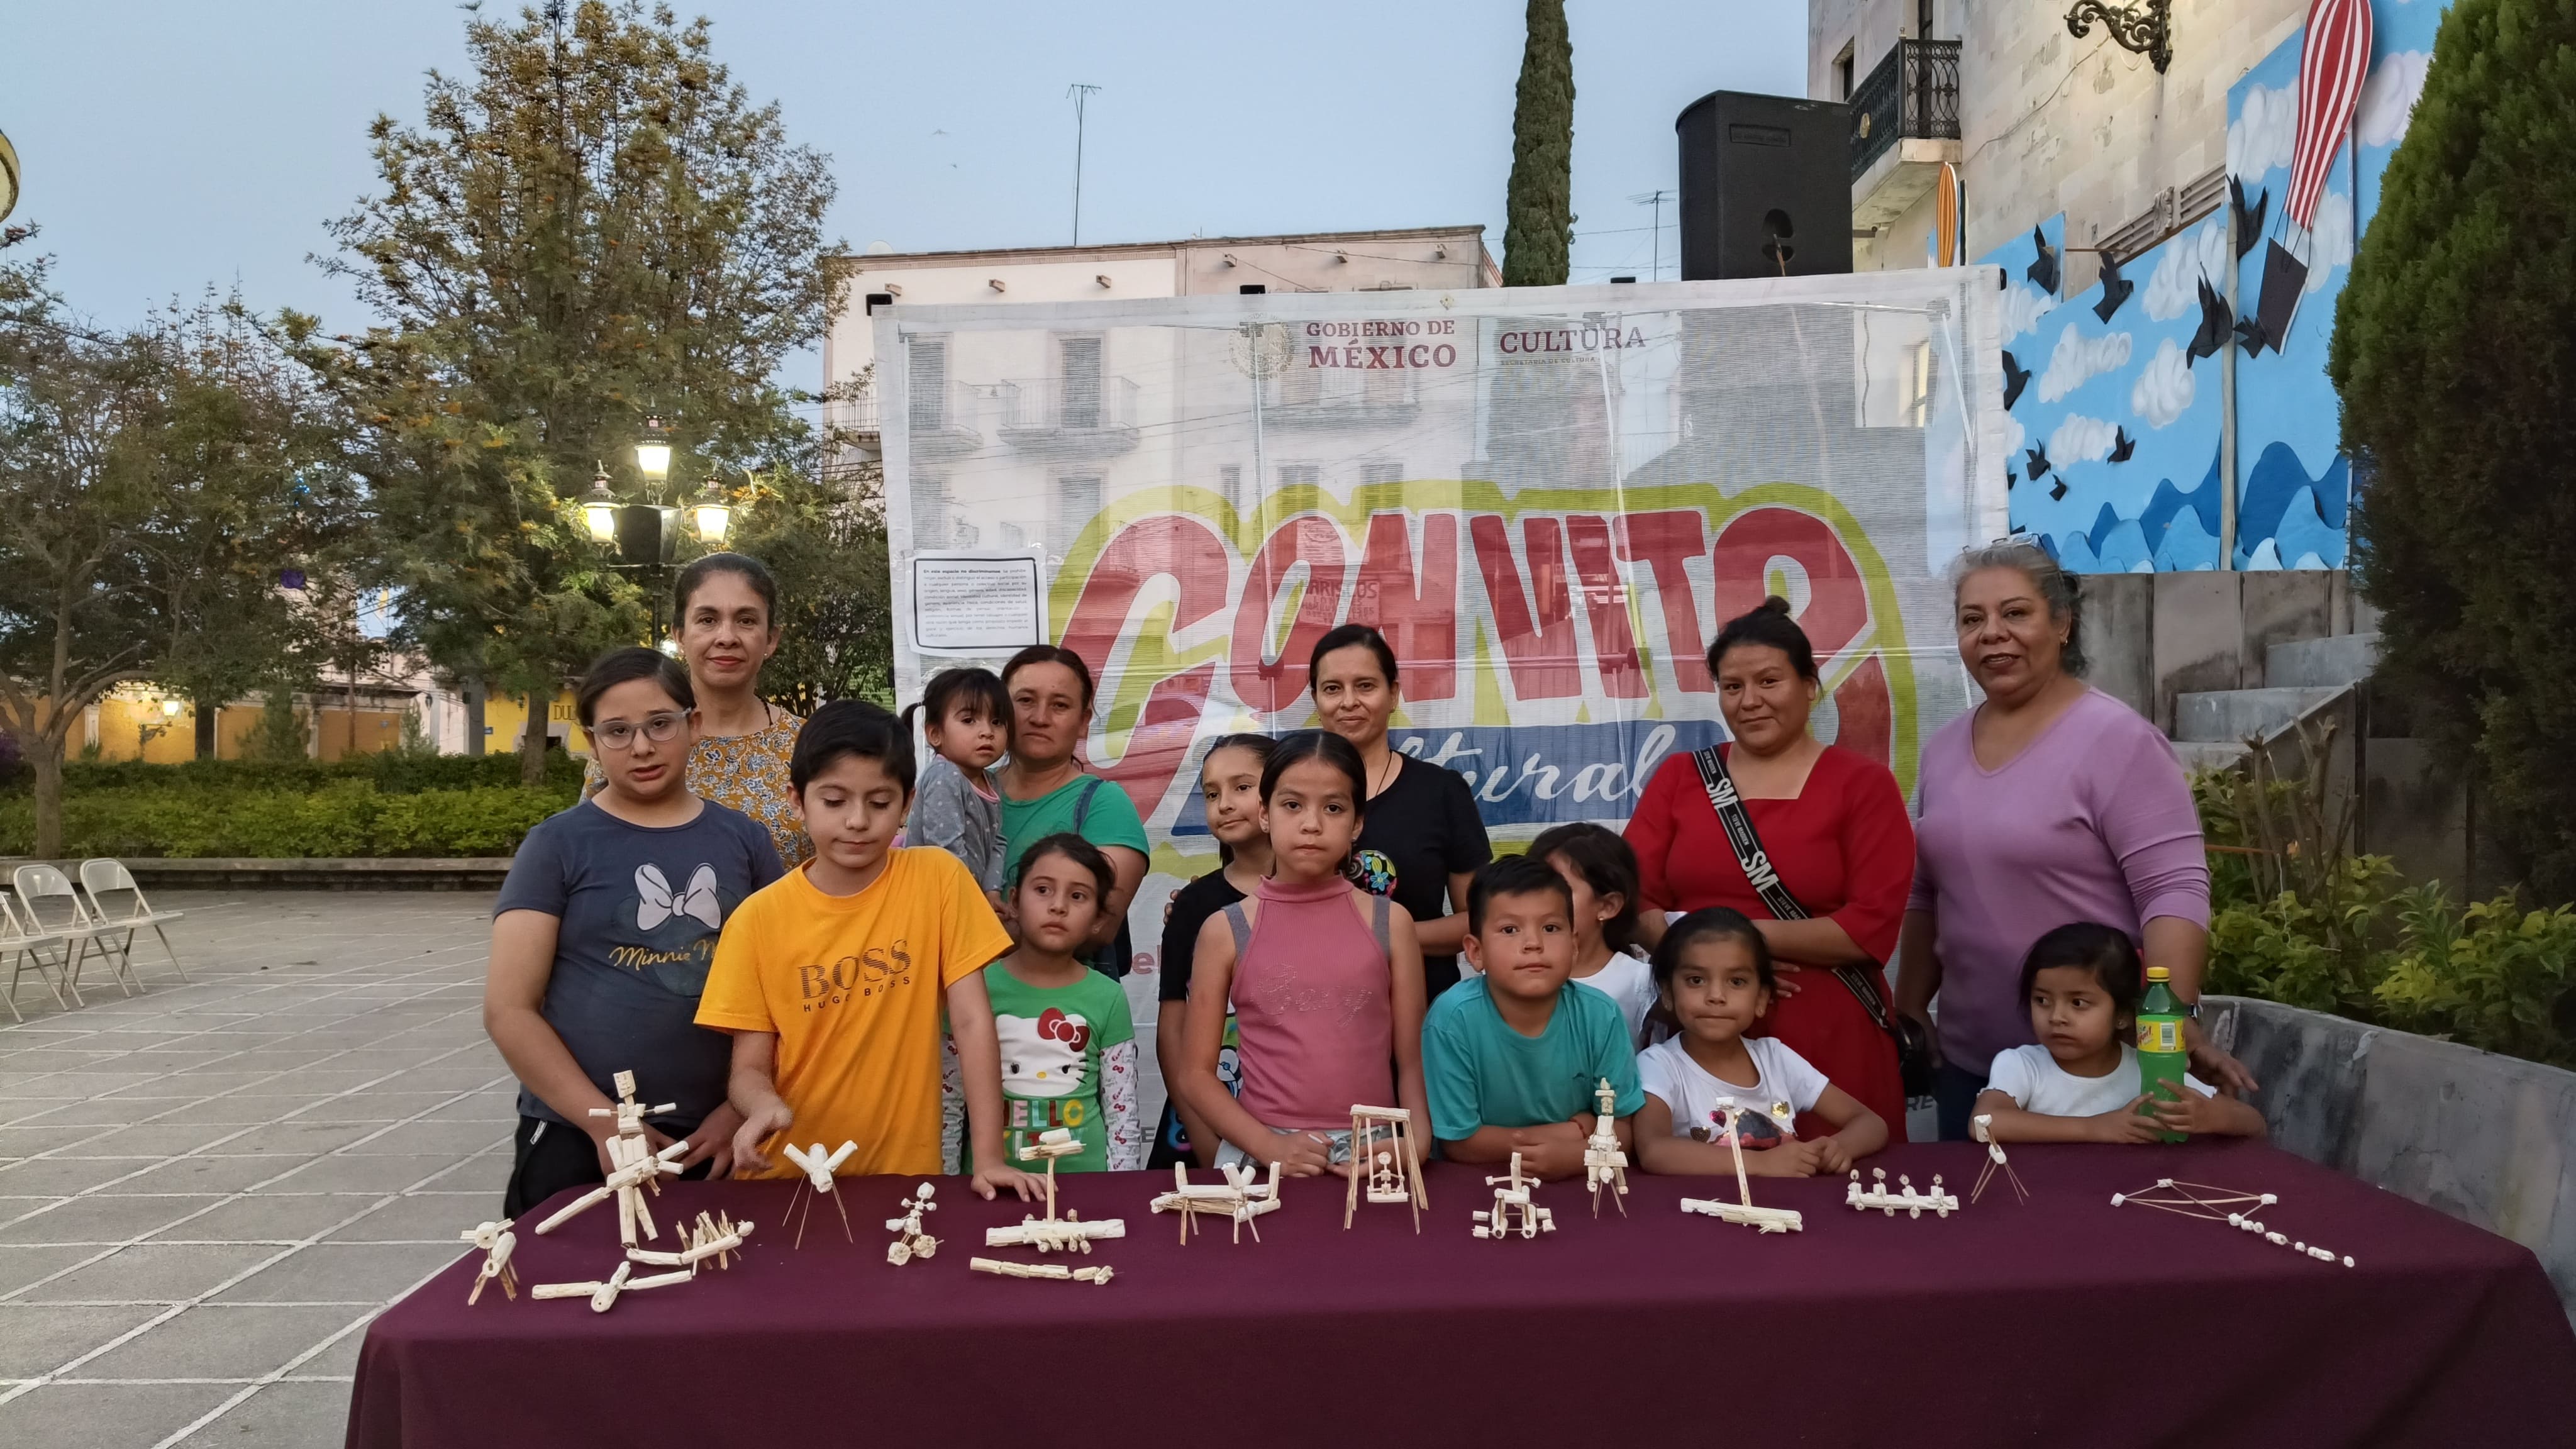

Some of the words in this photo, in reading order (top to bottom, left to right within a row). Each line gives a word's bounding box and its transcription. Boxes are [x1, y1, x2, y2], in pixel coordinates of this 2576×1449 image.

[1307, 321, 1421, 337] GOBIERNO
[1428, 319, 1455, 335] DE
[1499, 326, 1646, 353] CULTURA
[1308, 338, 1457, 369] MÉXICO
[1706, 777, 1738, 809] SM
[1741, 851, 1779, 893] SM
[609, 946, 690, 971] Minnie
[798, 939, 911, 999] BOSS
[803, 994, 851, 1012] HUGO
[864, 977, 911, 996] BOSS
